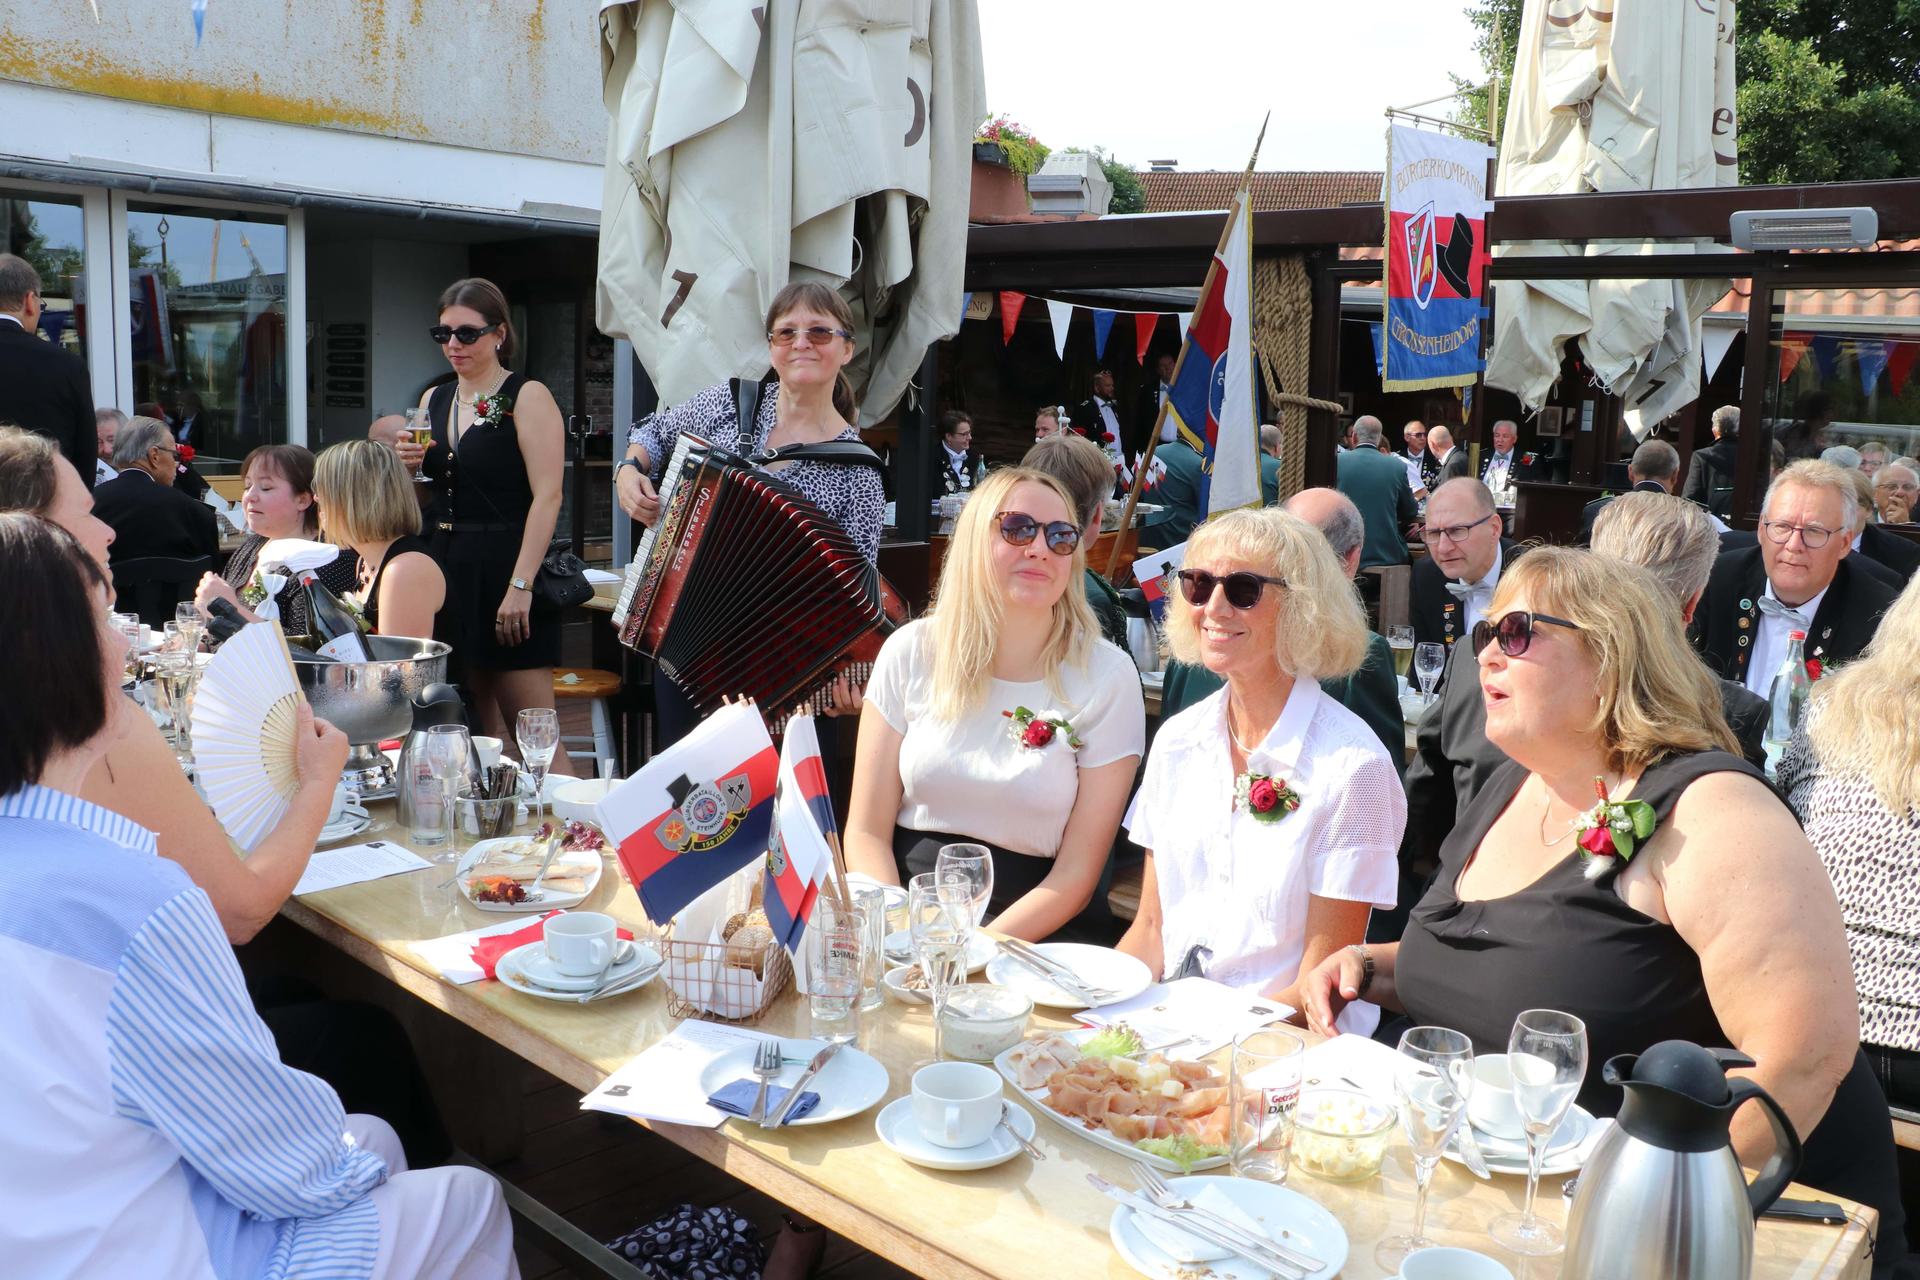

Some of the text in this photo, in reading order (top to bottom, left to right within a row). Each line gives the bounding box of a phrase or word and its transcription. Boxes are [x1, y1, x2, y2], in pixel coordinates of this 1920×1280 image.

[1391, 313, 1478, 356] GROSSENHEIDORN
[674, 487, 711, 572] SILBERBACH
[702, 824, 735, 849] 150 JAHRE
